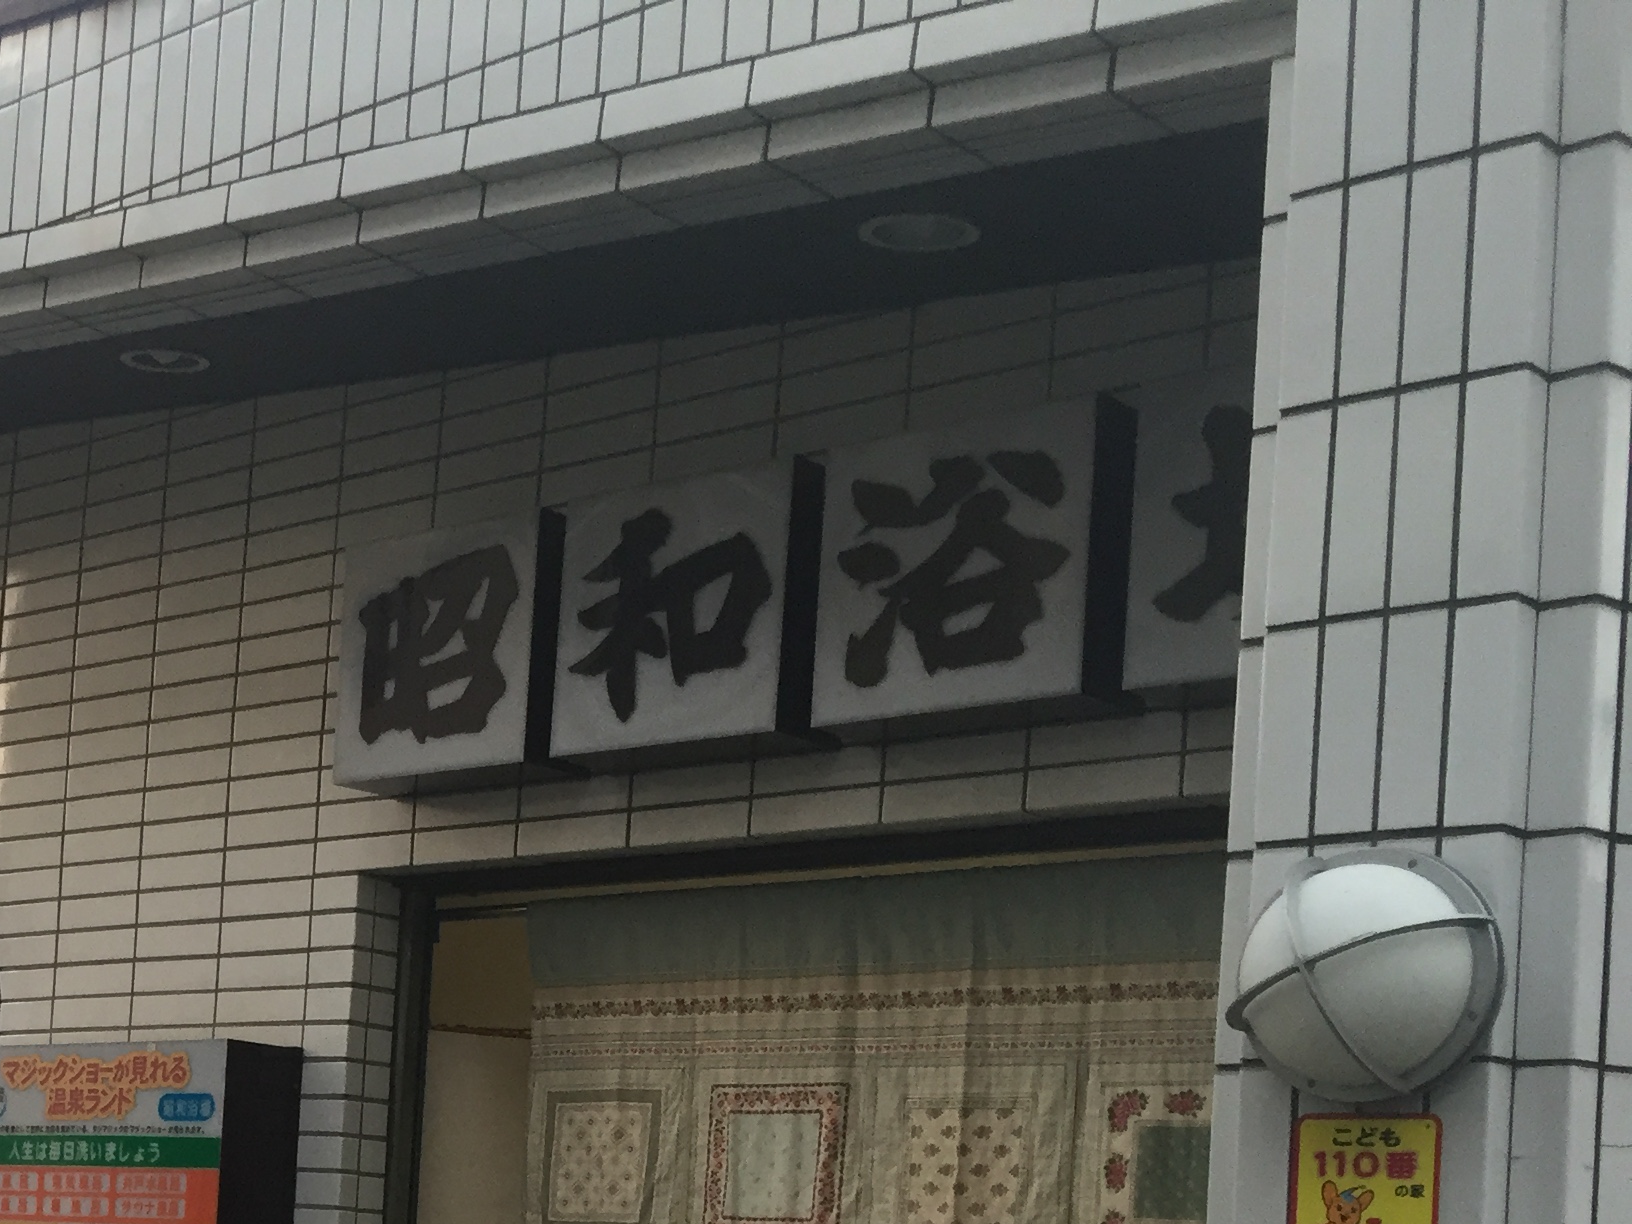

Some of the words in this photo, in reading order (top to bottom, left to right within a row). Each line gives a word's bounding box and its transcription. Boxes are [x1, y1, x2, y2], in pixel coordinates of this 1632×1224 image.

[2, 1055, 188, 1086] マジックショーが見れる
[47, 1087, 133, 1116] 温泉ランド
[9, 1140, 161, 1163] 人生は毎日洗いましょう
[1332, 1127, 1401, 1147] こども
[1313, 1151, 1417, 1180] 110番
